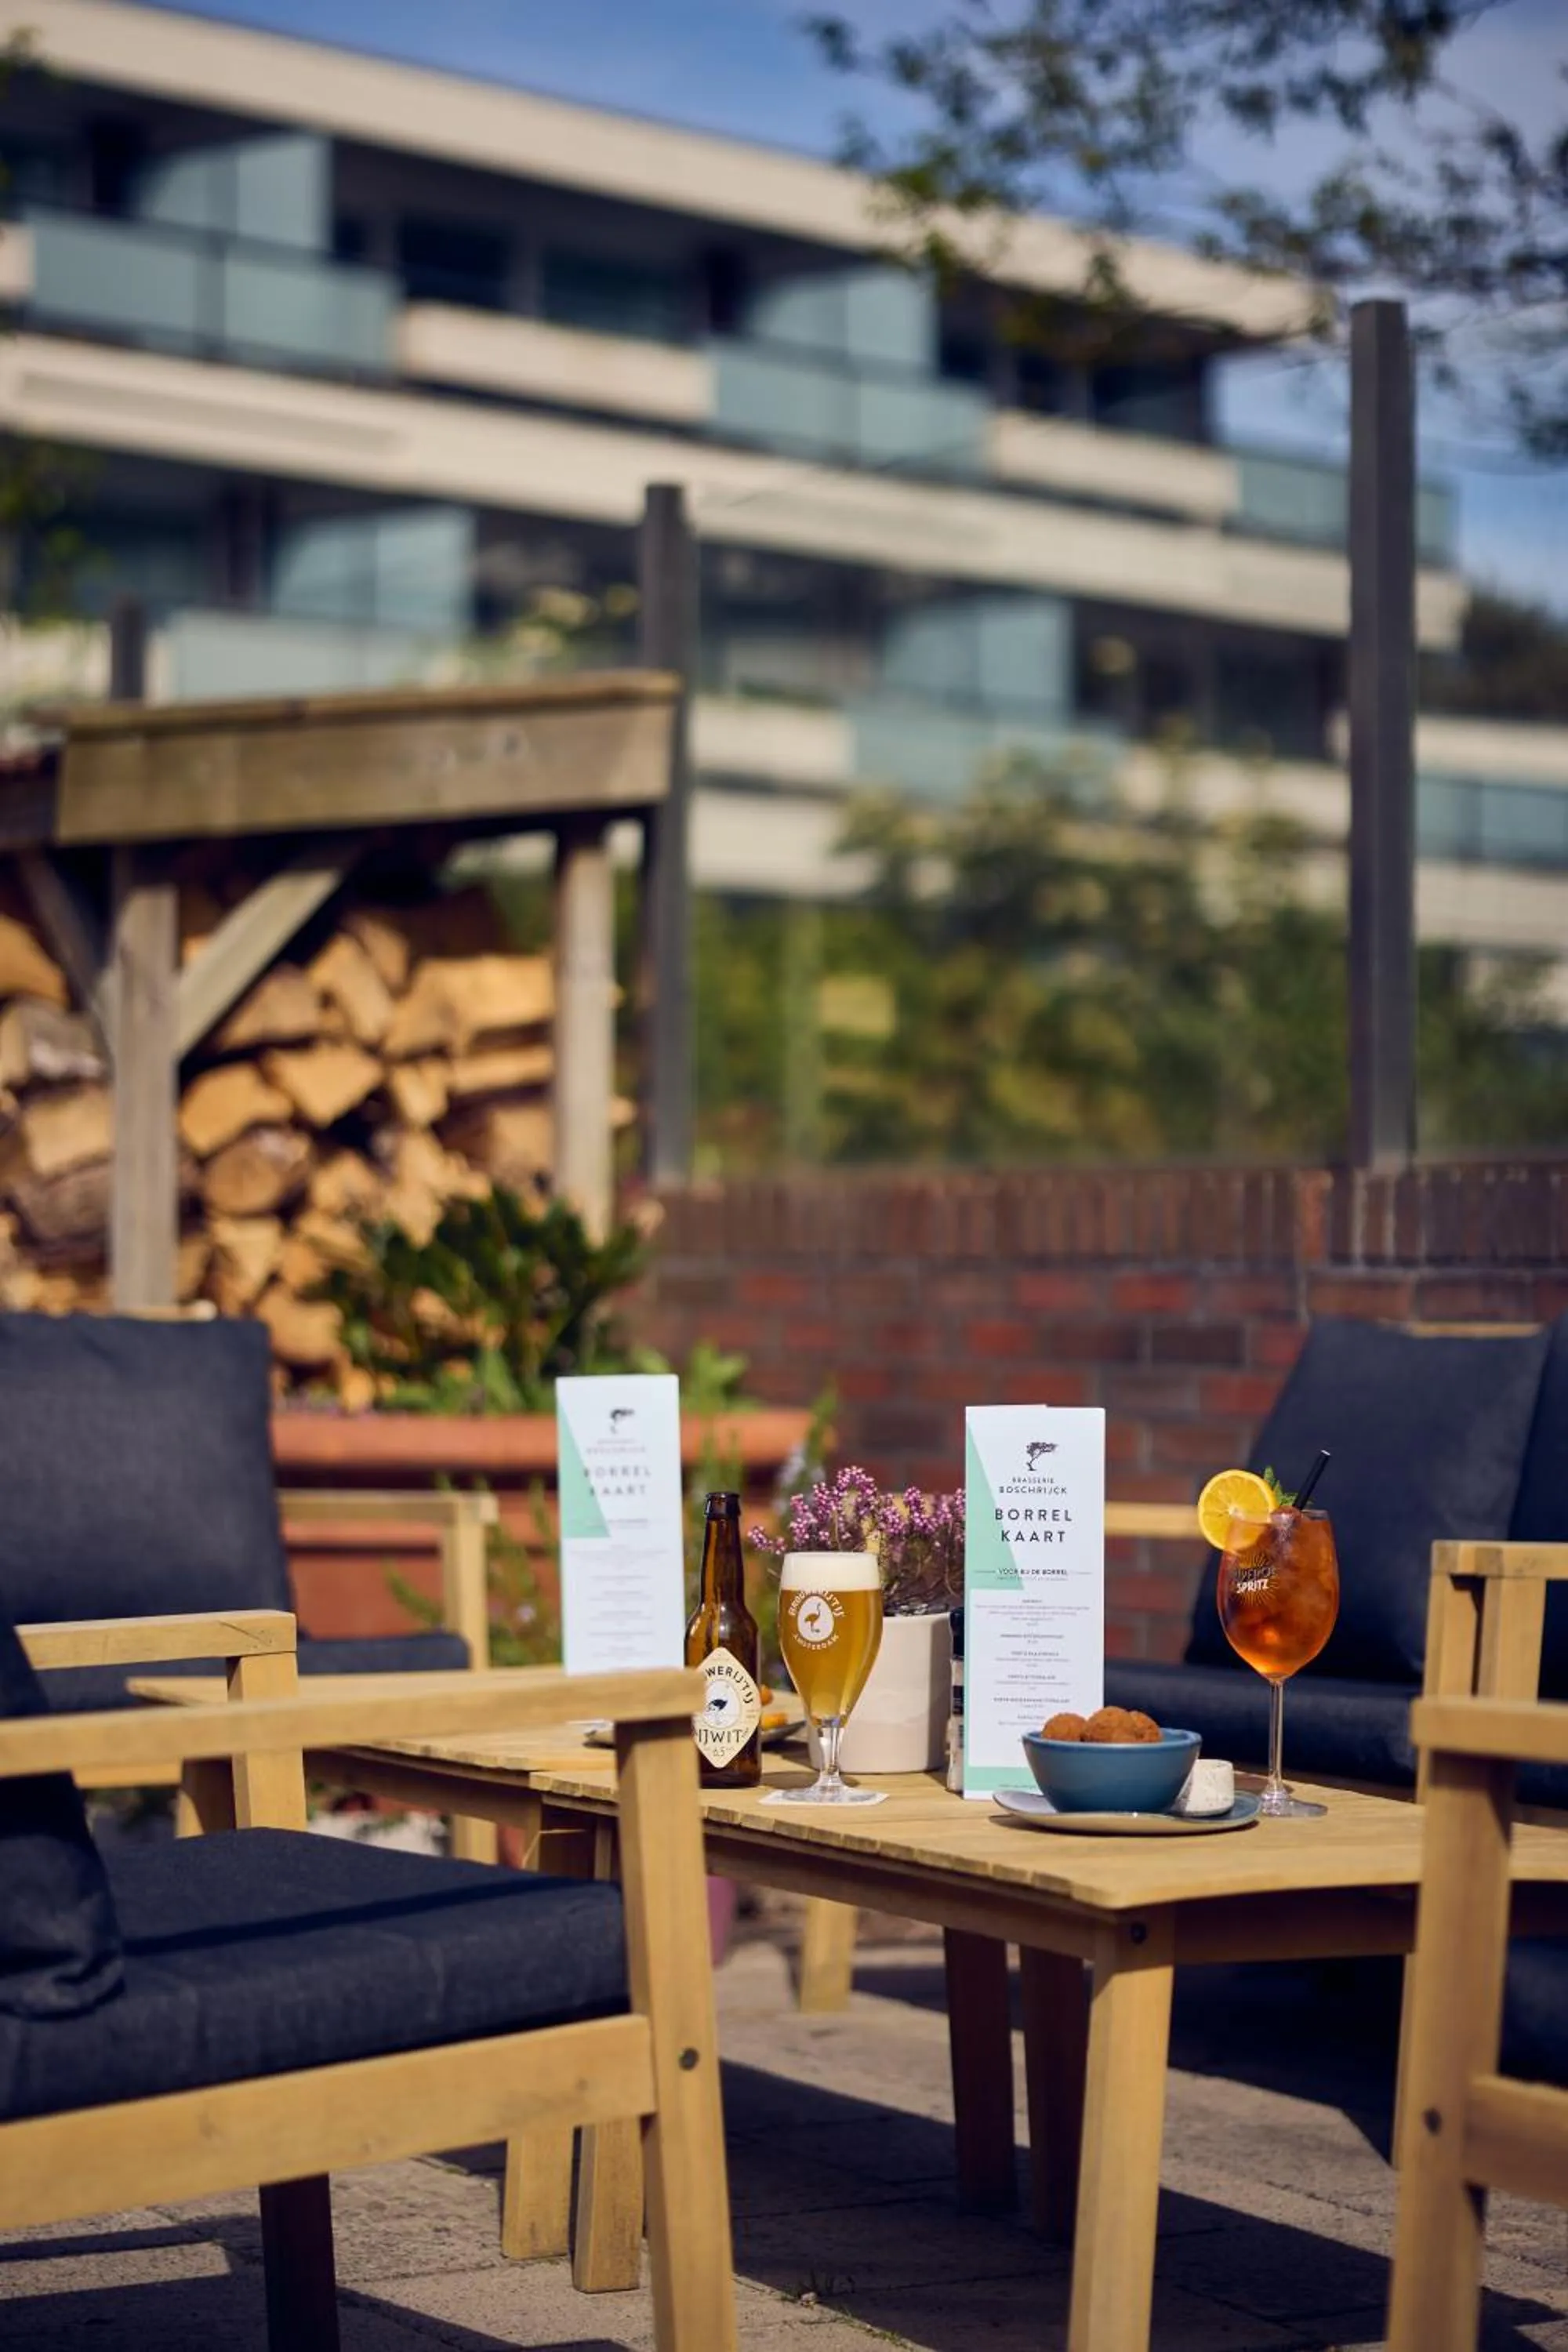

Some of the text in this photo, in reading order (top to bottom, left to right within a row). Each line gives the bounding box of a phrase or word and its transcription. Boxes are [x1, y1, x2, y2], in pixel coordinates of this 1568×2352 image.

[995, 1508, 1073, 1522] BORREL
[1001, 1530, 1065, 1543] KAART
[1236, 1578, 1269, 1593] SPRITZ
[699, 1729, 742, 1744] IJWIT
